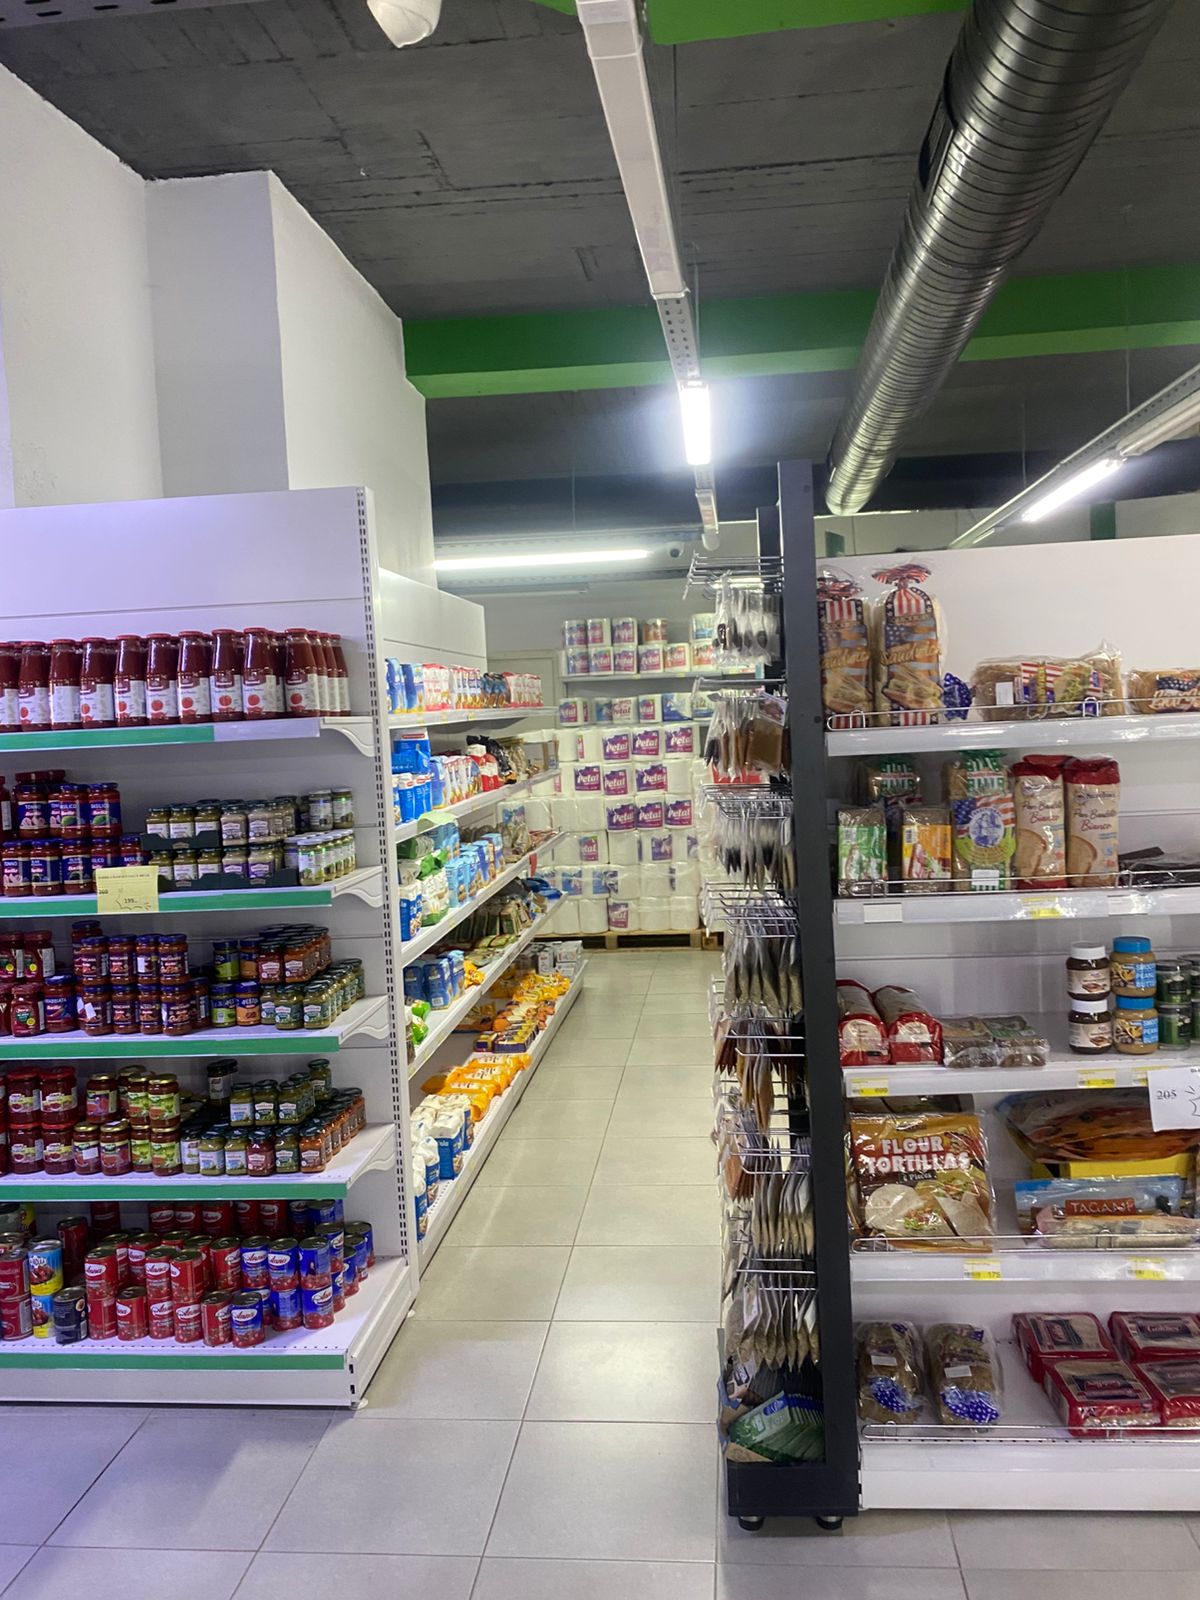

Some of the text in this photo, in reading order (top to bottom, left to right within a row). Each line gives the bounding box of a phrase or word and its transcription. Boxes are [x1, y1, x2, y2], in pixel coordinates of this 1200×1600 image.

[605, 740, 628, 753] Petal
[635, 738, 658, 749] Petal
[577, 771, 600, 784] Petal
[604, 777, 626, 789] Petal
[612, 811, 635, 825] Petal
[638, 810, 661, 823] Petal
[668, 805, 691, 818] Petal
[882, 1135, 944, 1155] FLOUR
[861, 1151, 971, 1175] TORTILLAS
